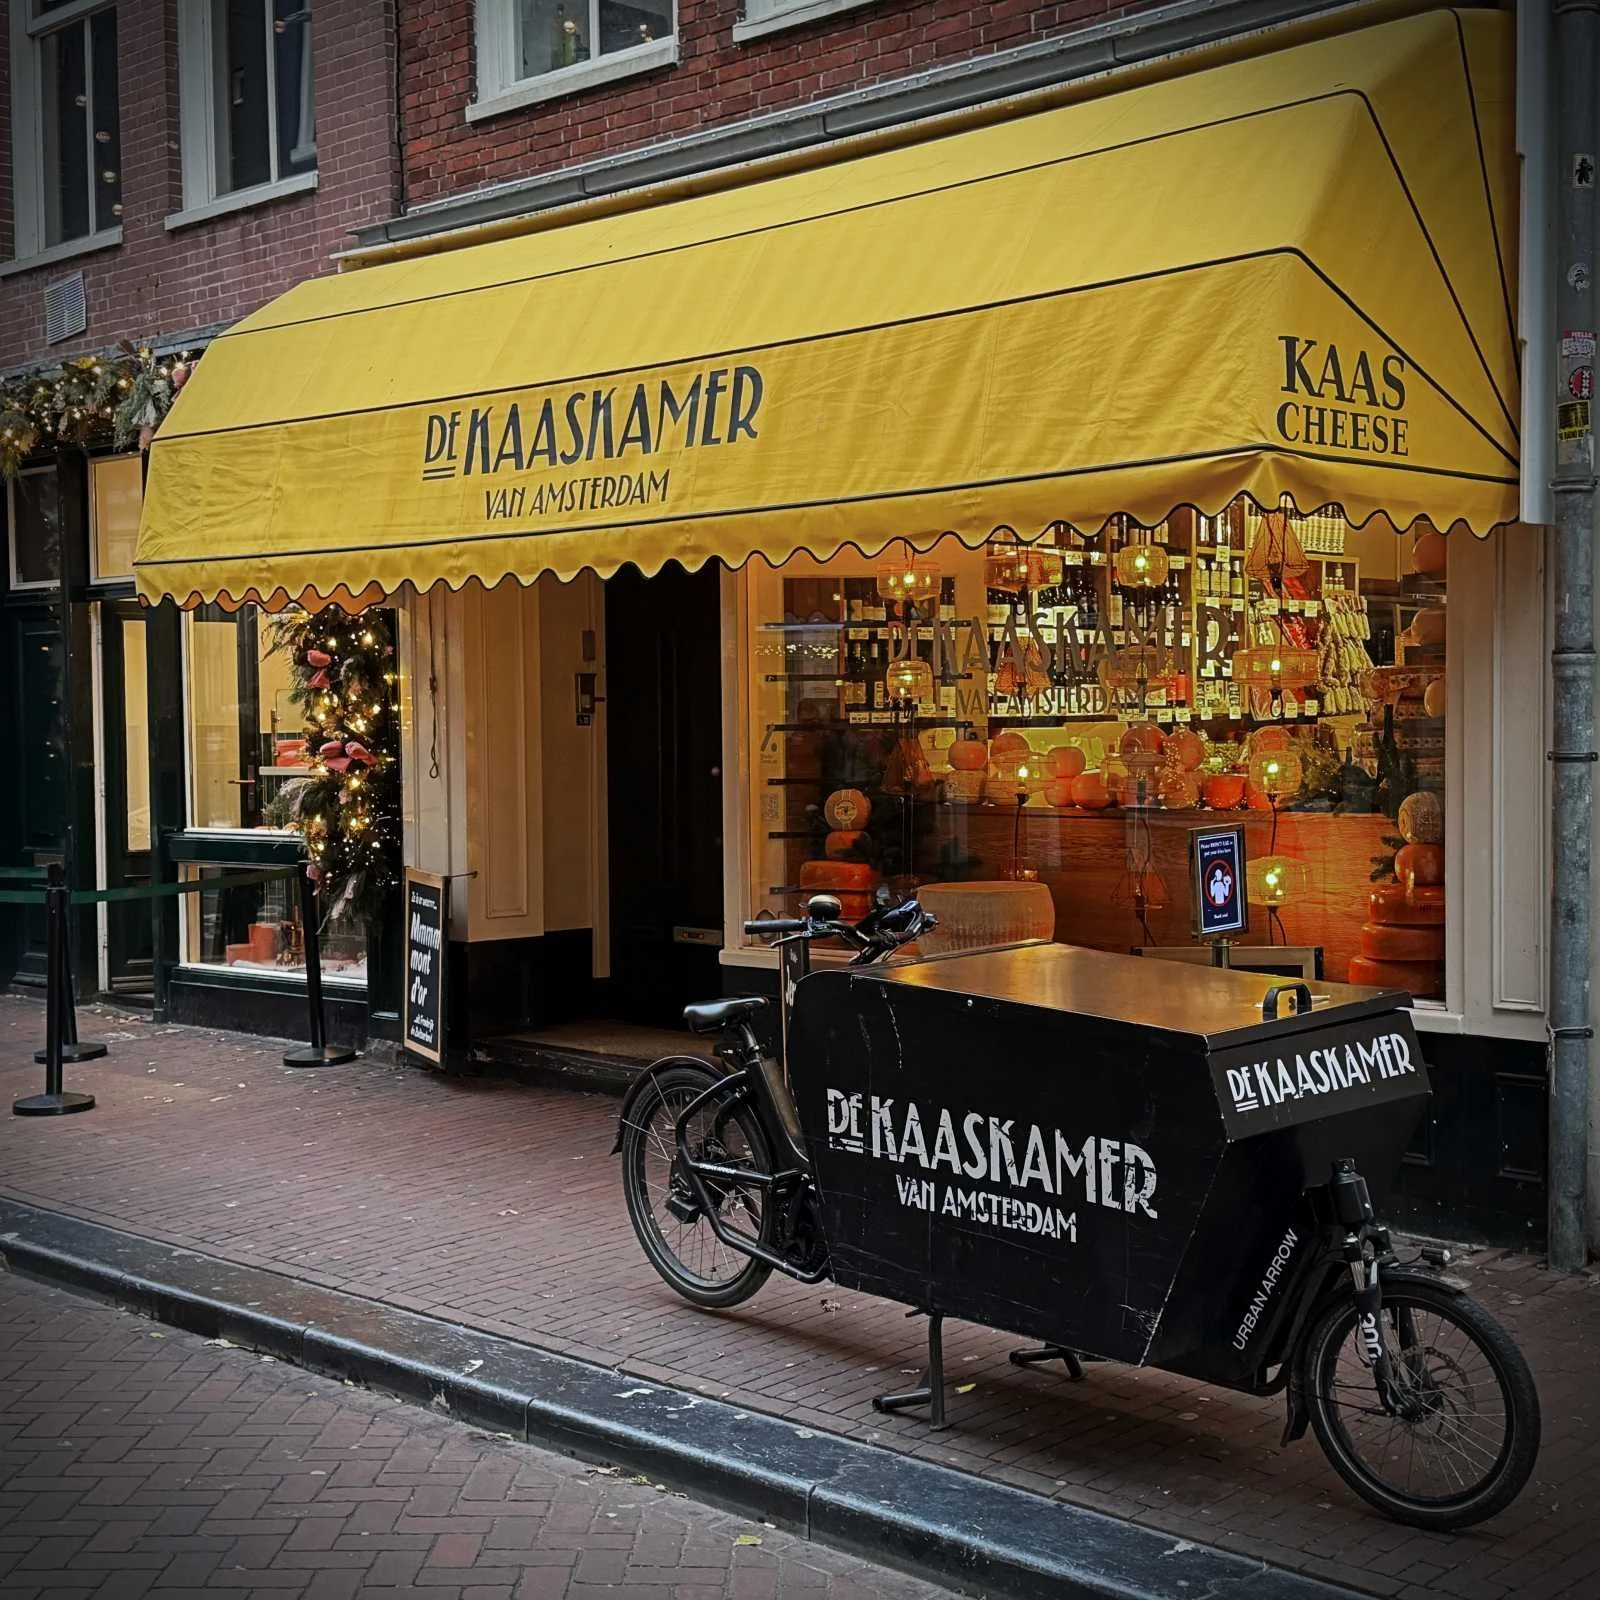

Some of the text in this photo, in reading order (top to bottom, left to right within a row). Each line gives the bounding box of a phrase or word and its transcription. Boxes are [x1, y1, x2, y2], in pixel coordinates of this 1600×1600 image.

[1278, 336, 1406, 411] KAAS
[463, 366, 763, 475] KAASKAMER
[1277, 402, 1409, 456] CHEESE
[485, 468, 670, 520] VAN AMSTERDAM
[933, 605, 1231, 676] KAASKAMER
[957, 688, 999, 715] VAN
[1006, 684, 1146, 715] AMSTERDAM
[410, 949, 431, 976] mont
[1254, 1033, 1415, 1106] KAASKAMER
[871, 1095, 1158, 1219] KAASKAMER
[896, 1174, 1077, 1243] VAN AMSTERDAM
[1232, 1227, 1299, 1350] URBAN ARROW
